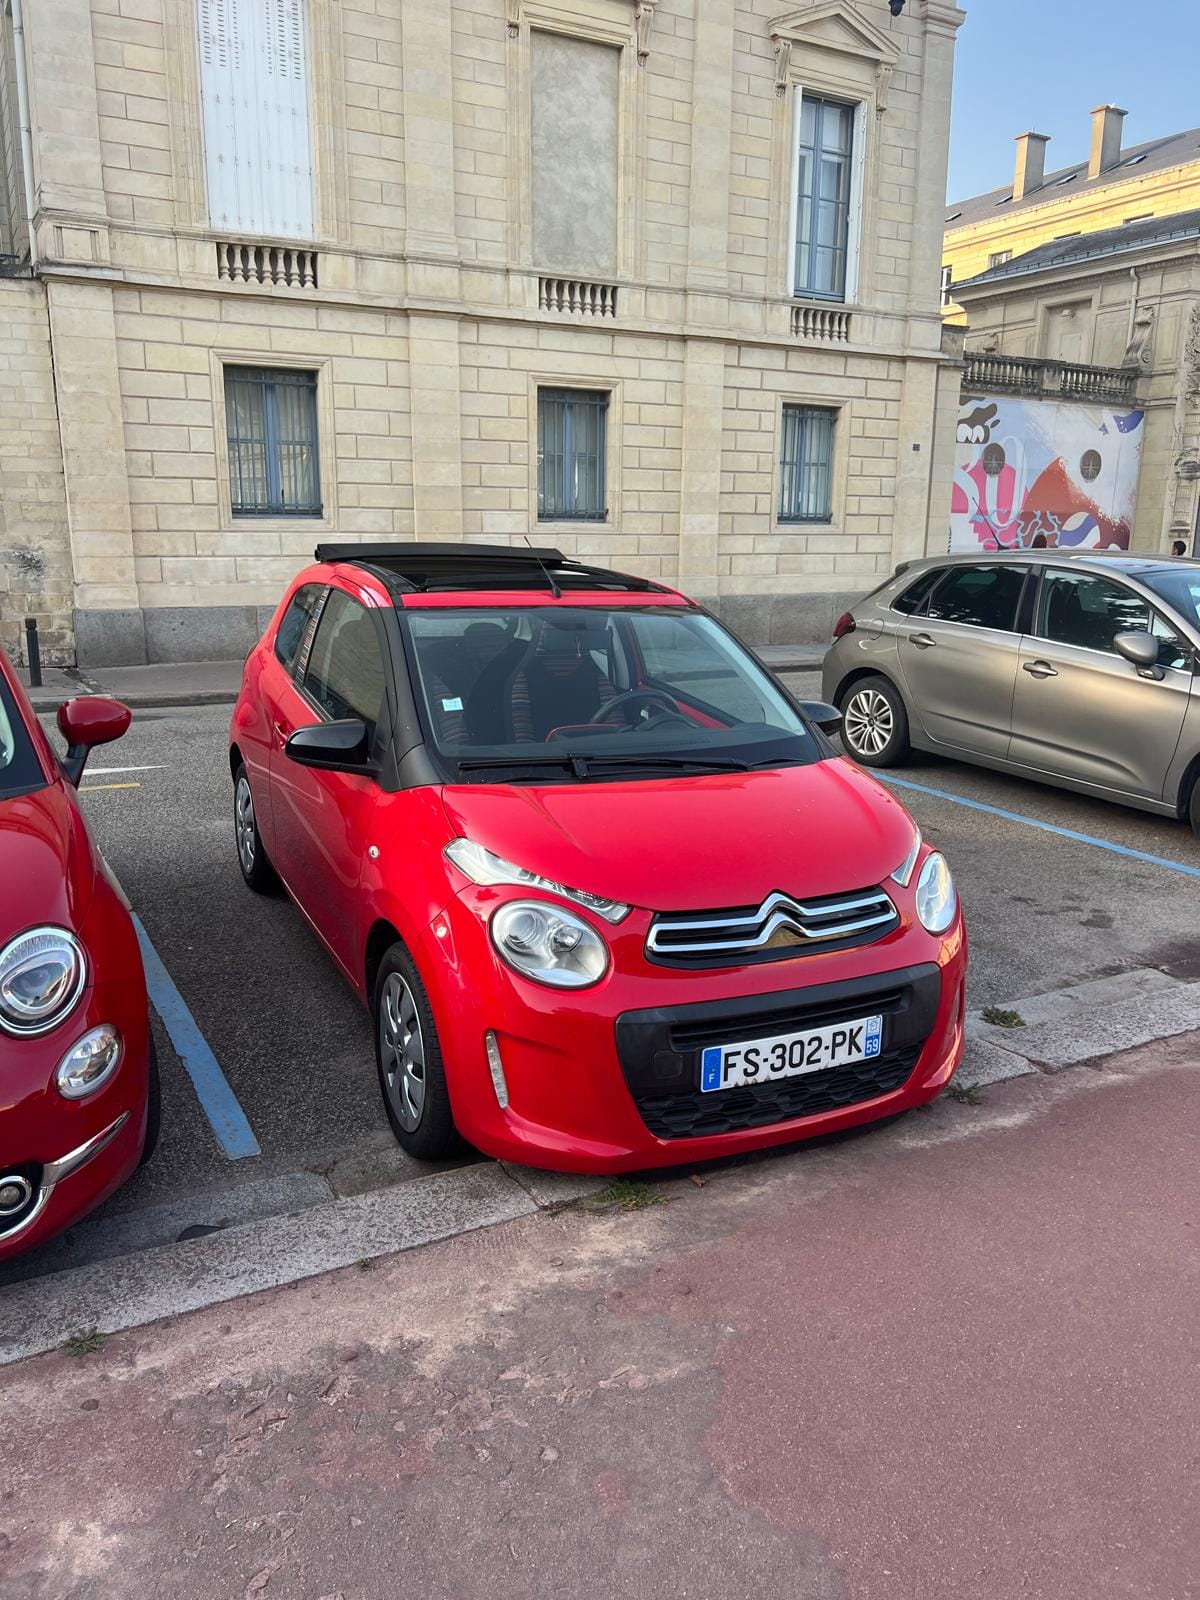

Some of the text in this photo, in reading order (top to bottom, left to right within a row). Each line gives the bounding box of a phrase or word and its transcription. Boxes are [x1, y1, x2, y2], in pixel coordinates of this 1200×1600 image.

[722, 1025, 864, 1082] FS-302-PK
[865, 1038, 879, 1054] 59
[708, 1073, 715, 1083] F
